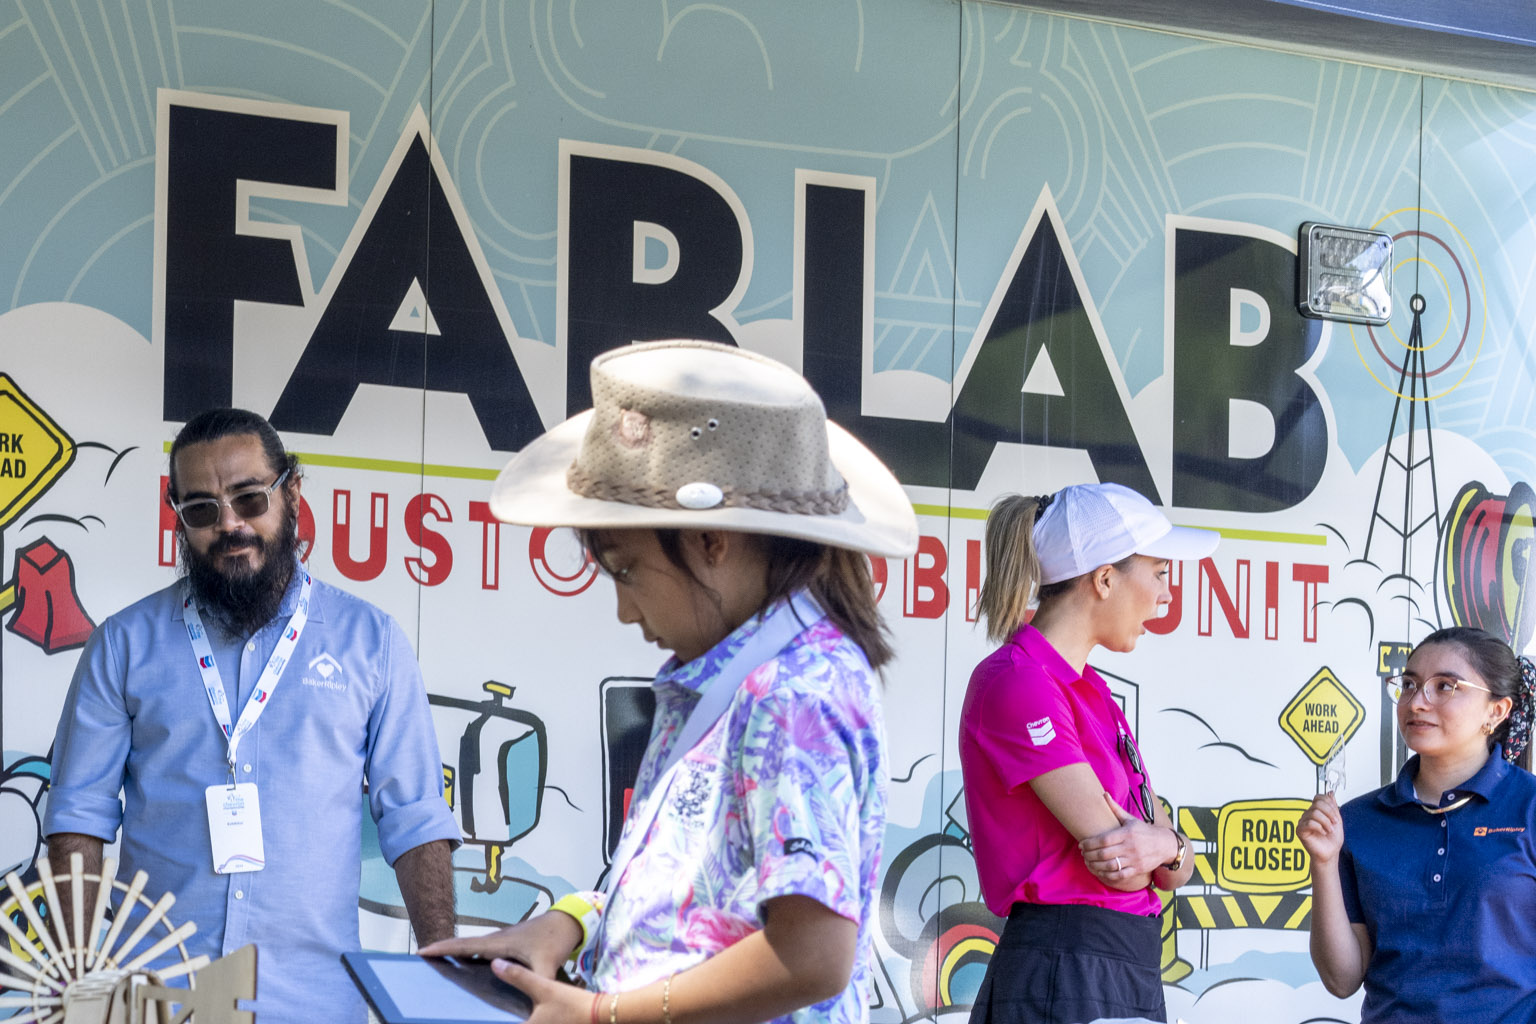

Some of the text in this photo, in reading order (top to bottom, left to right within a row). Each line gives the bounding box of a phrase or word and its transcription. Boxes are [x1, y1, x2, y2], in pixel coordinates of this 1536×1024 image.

[158, 475, 604, 598] USTO
[1305, 702, 1338, 717] WORK
[1302, 719, 1340, 734] AHEAD
[1242, 818, 1295, 843] ROAD
[1230, 845, 1306, 871] CLOSED
